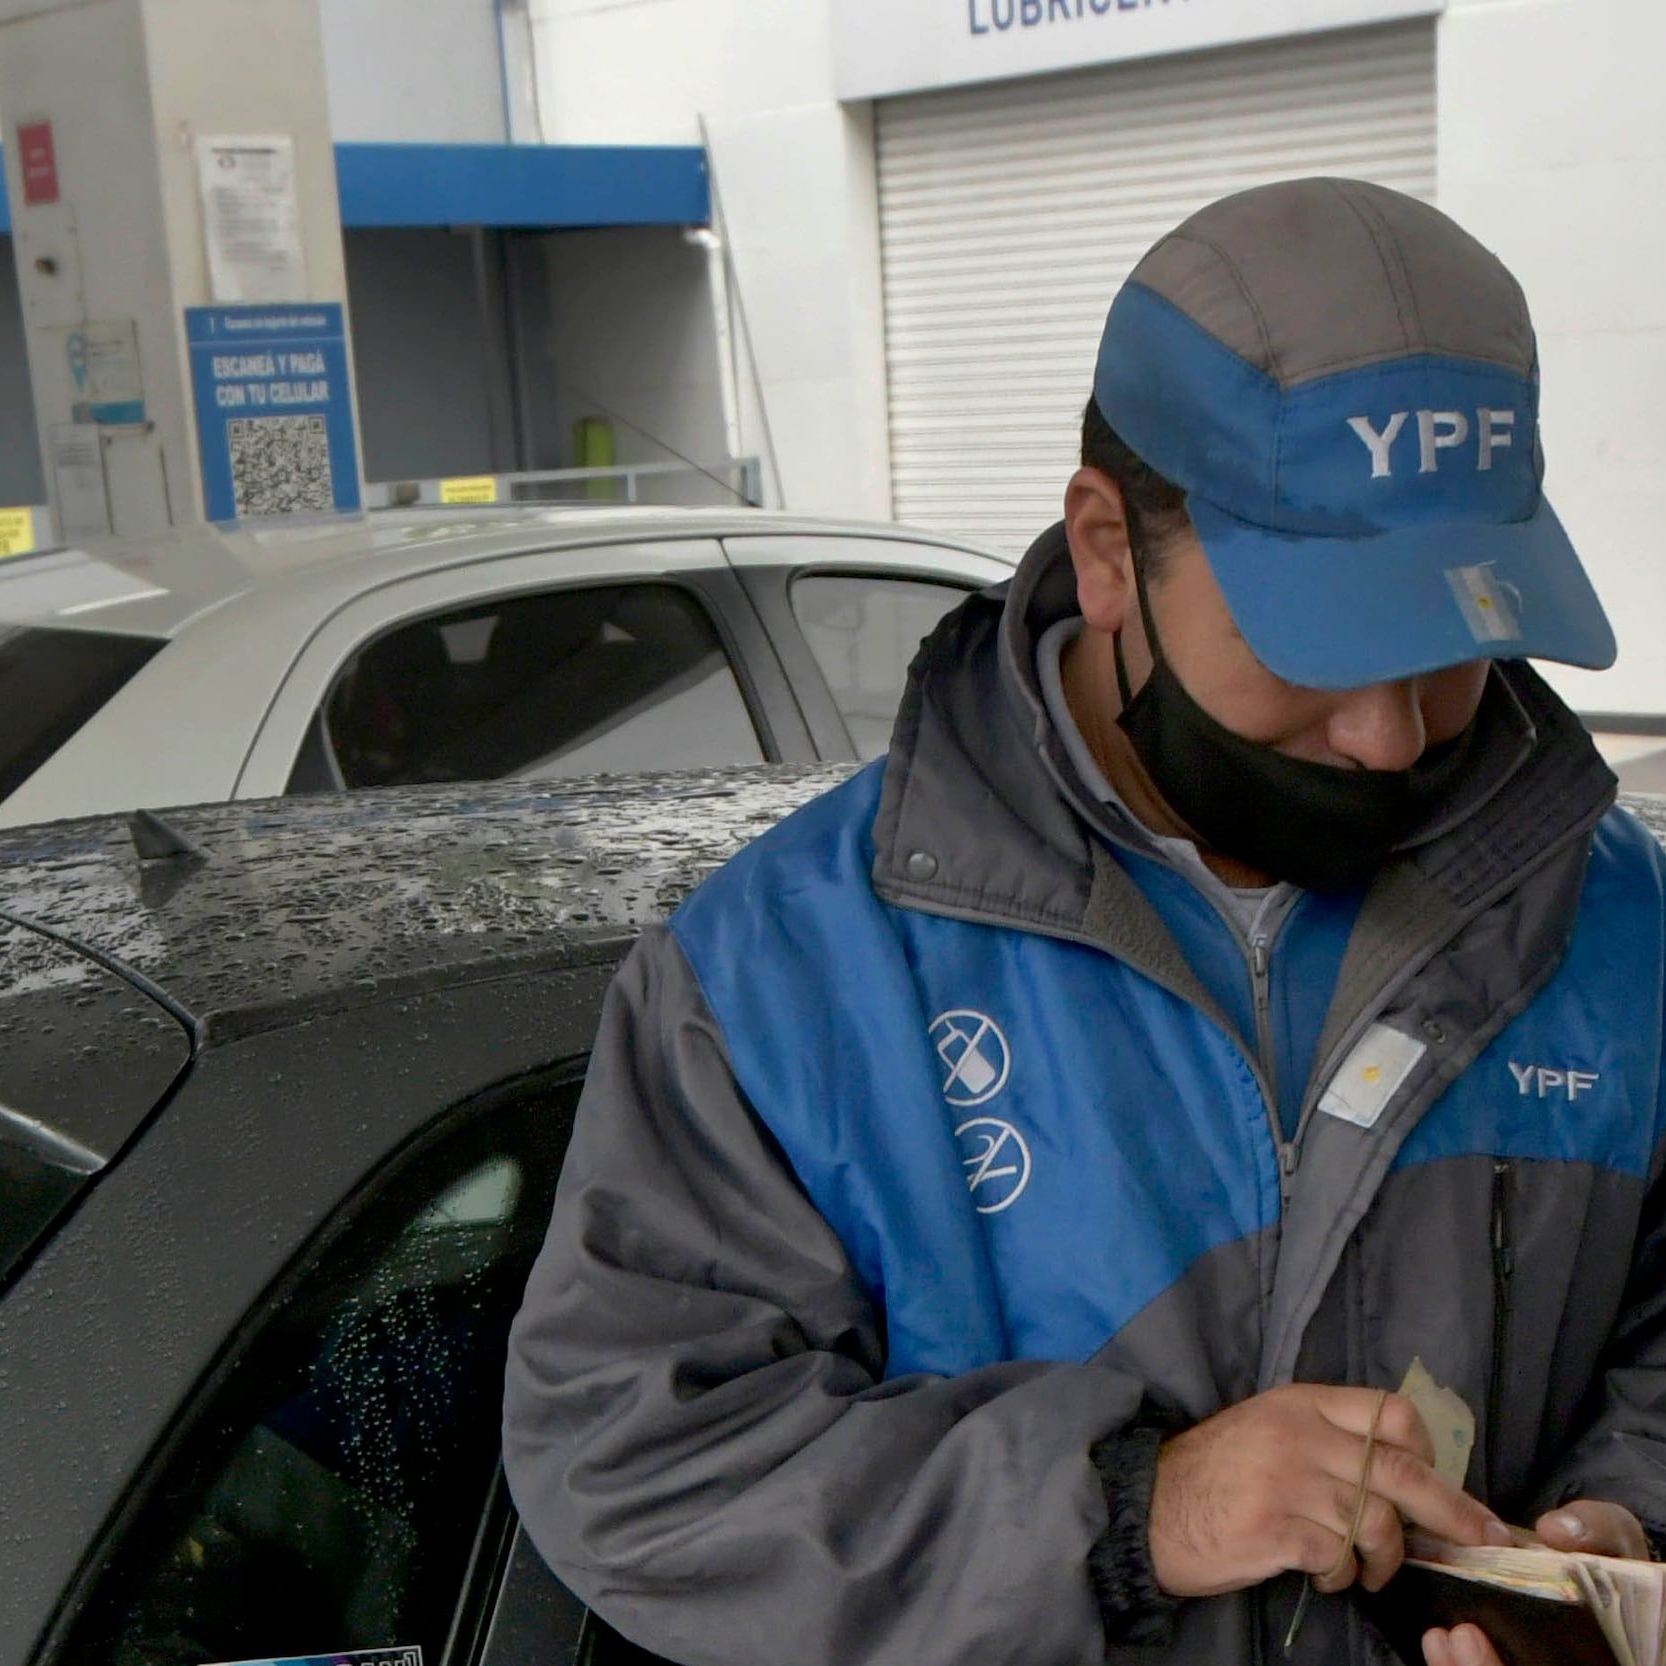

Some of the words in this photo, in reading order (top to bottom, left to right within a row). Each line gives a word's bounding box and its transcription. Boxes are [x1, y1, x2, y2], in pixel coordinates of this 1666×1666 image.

[277, 353, 288, 375] Y
[216, 384, 246, 407] CON
[247, 383, 267, 405] TU
[269, 380, 330, 404] CELULAR
[1346, 408, 1516, 479] YPF
[1506, 1059, 1600, 1103] YPF
